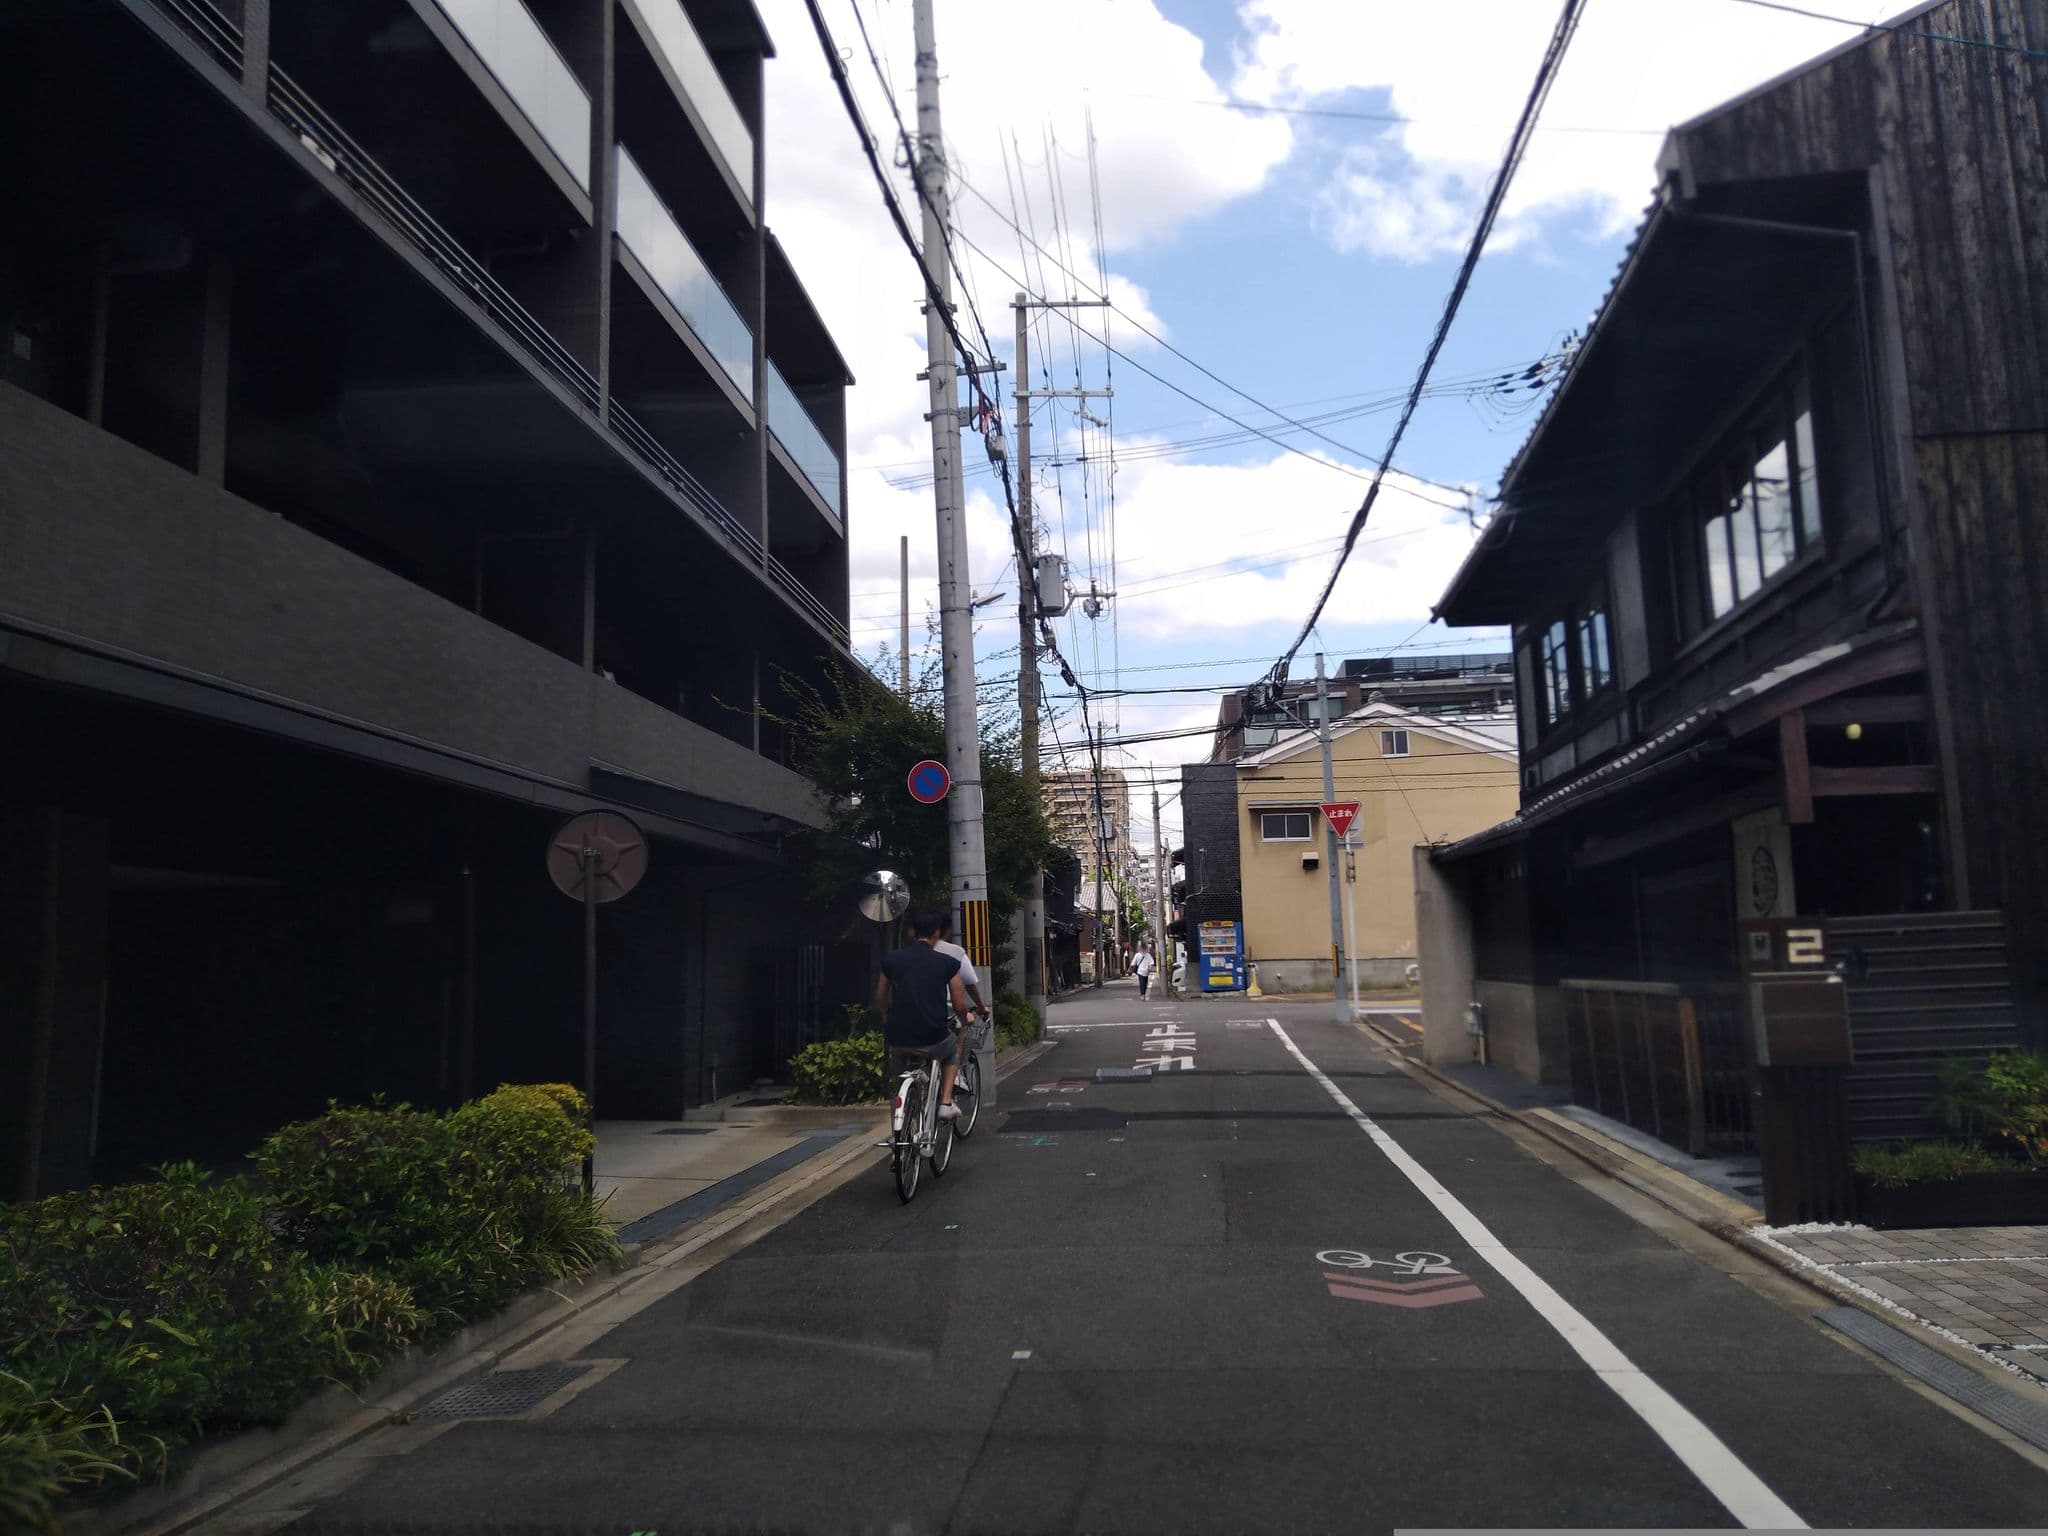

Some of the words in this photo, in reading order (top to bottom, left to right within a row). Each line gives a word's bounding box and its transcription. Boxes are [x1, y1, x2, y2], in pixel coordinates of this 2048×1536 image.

[1329, 809, 1352, 818] 止まれ
[1133, 1024, 1197, 1071] 止まれ
